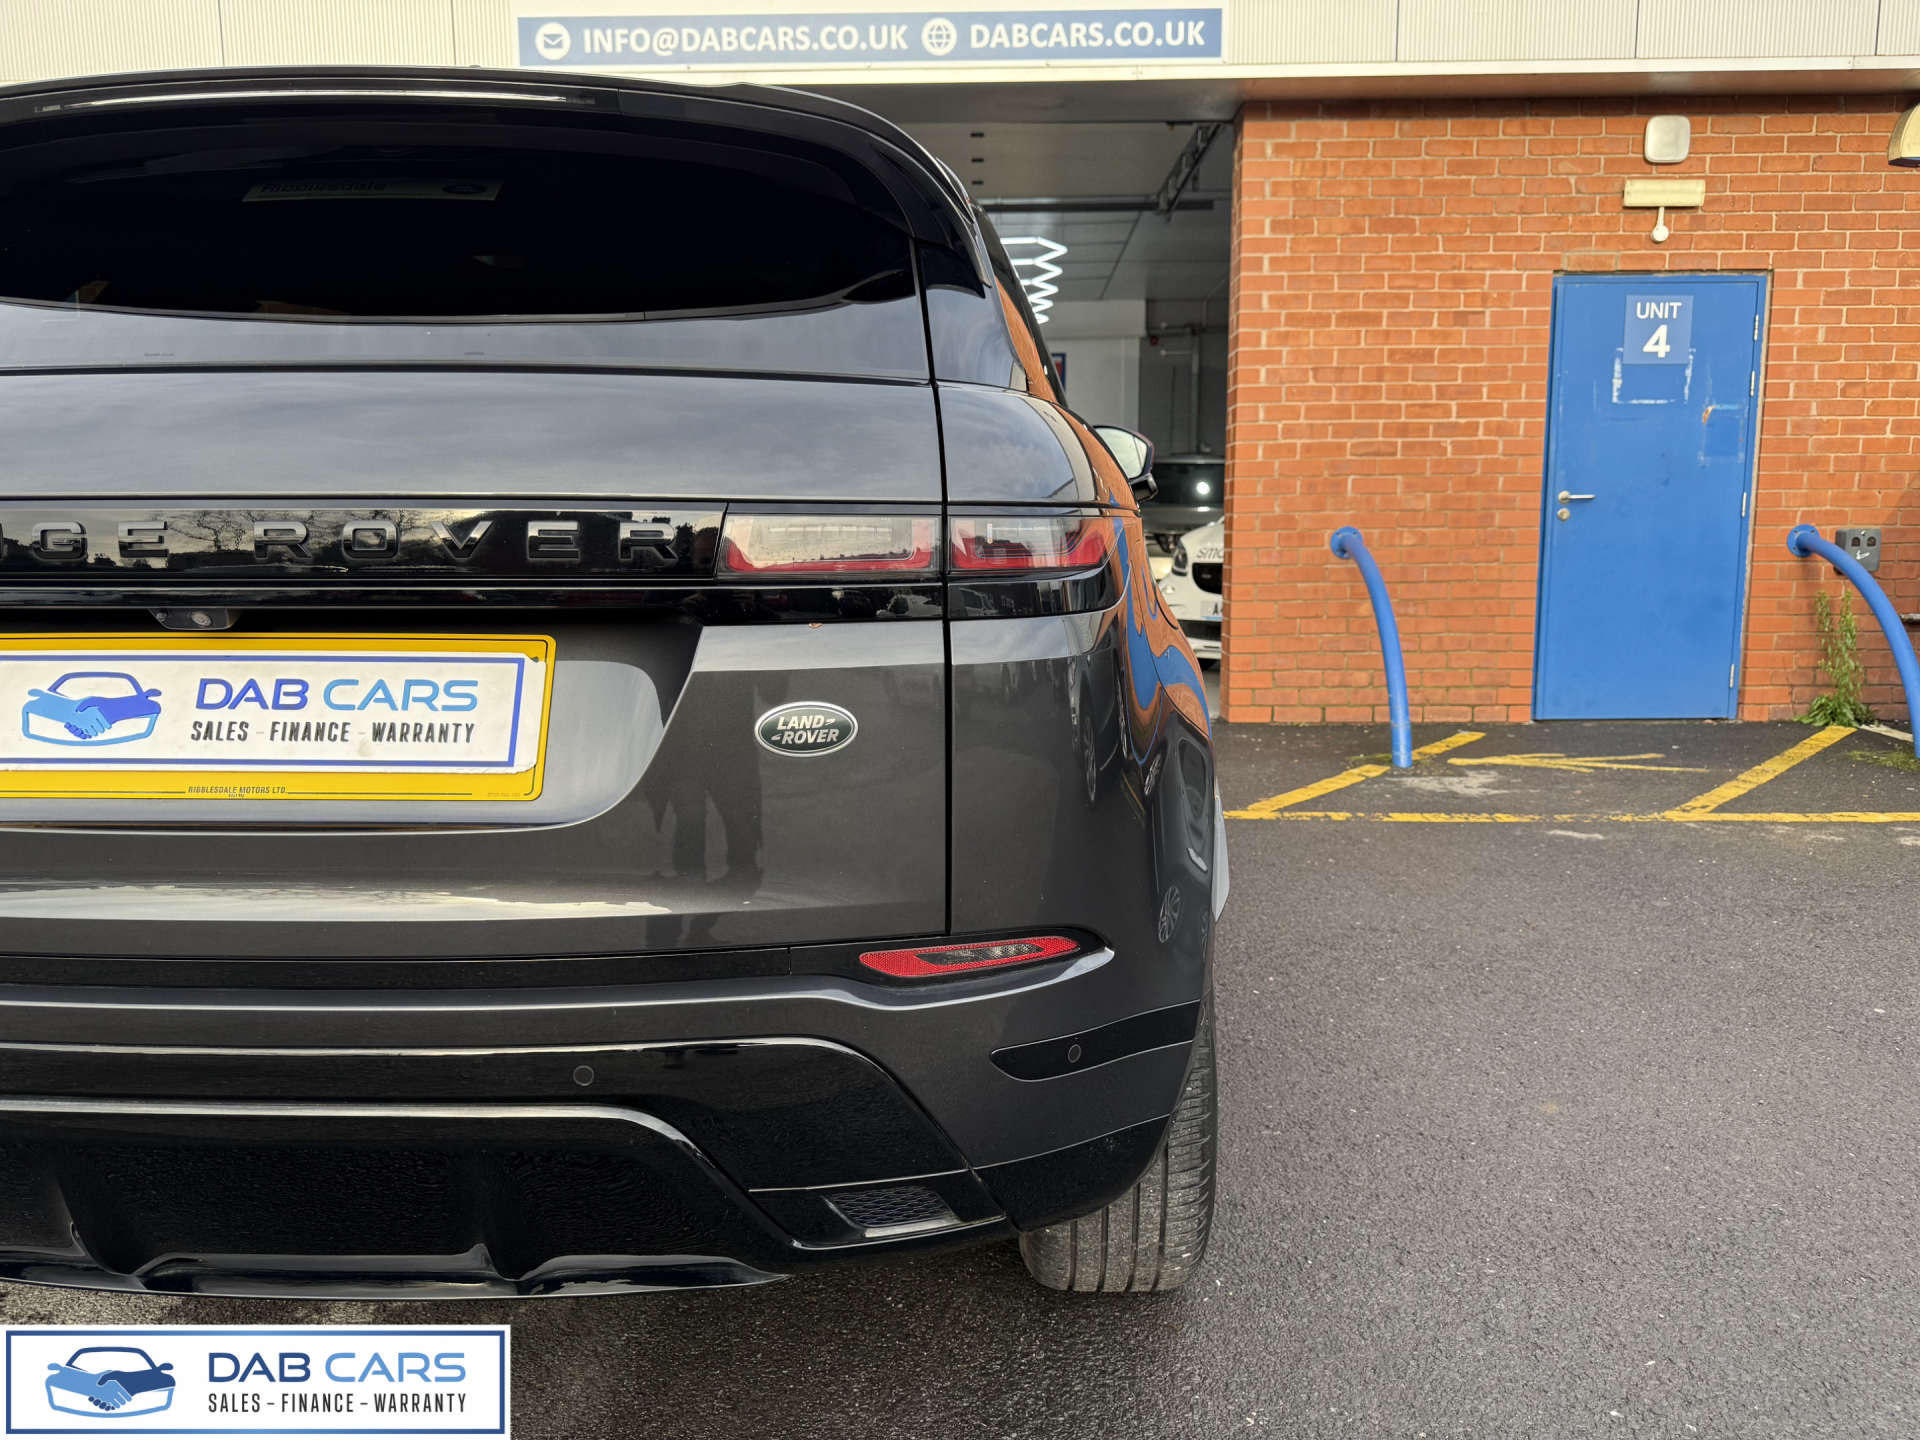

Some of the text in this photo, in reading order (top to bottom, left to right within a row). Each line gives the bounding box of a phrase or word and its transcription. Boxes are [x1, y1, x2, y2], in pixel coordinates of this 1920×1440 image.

[583, 20, 1206, 56] INFO@DABCARS.CO.UK DABCARS.CO.UK
[1636, 301, 1683, 319] UNIT
[1642, 324, 1671, 358] 4
[0, 520, 678, 564] GE ROVER
[195, 677, 479, 712] DAB CARS
[190, 720, 249, 742] SALES
[269, 721, 351, 743] FINANCE
[371, 722, 475, 743] WARRANTY
[777, 715, 824, 730] LAND
[782, 729, 839, 744] ROVER
[239, 786, 270, 794] MOTORS
